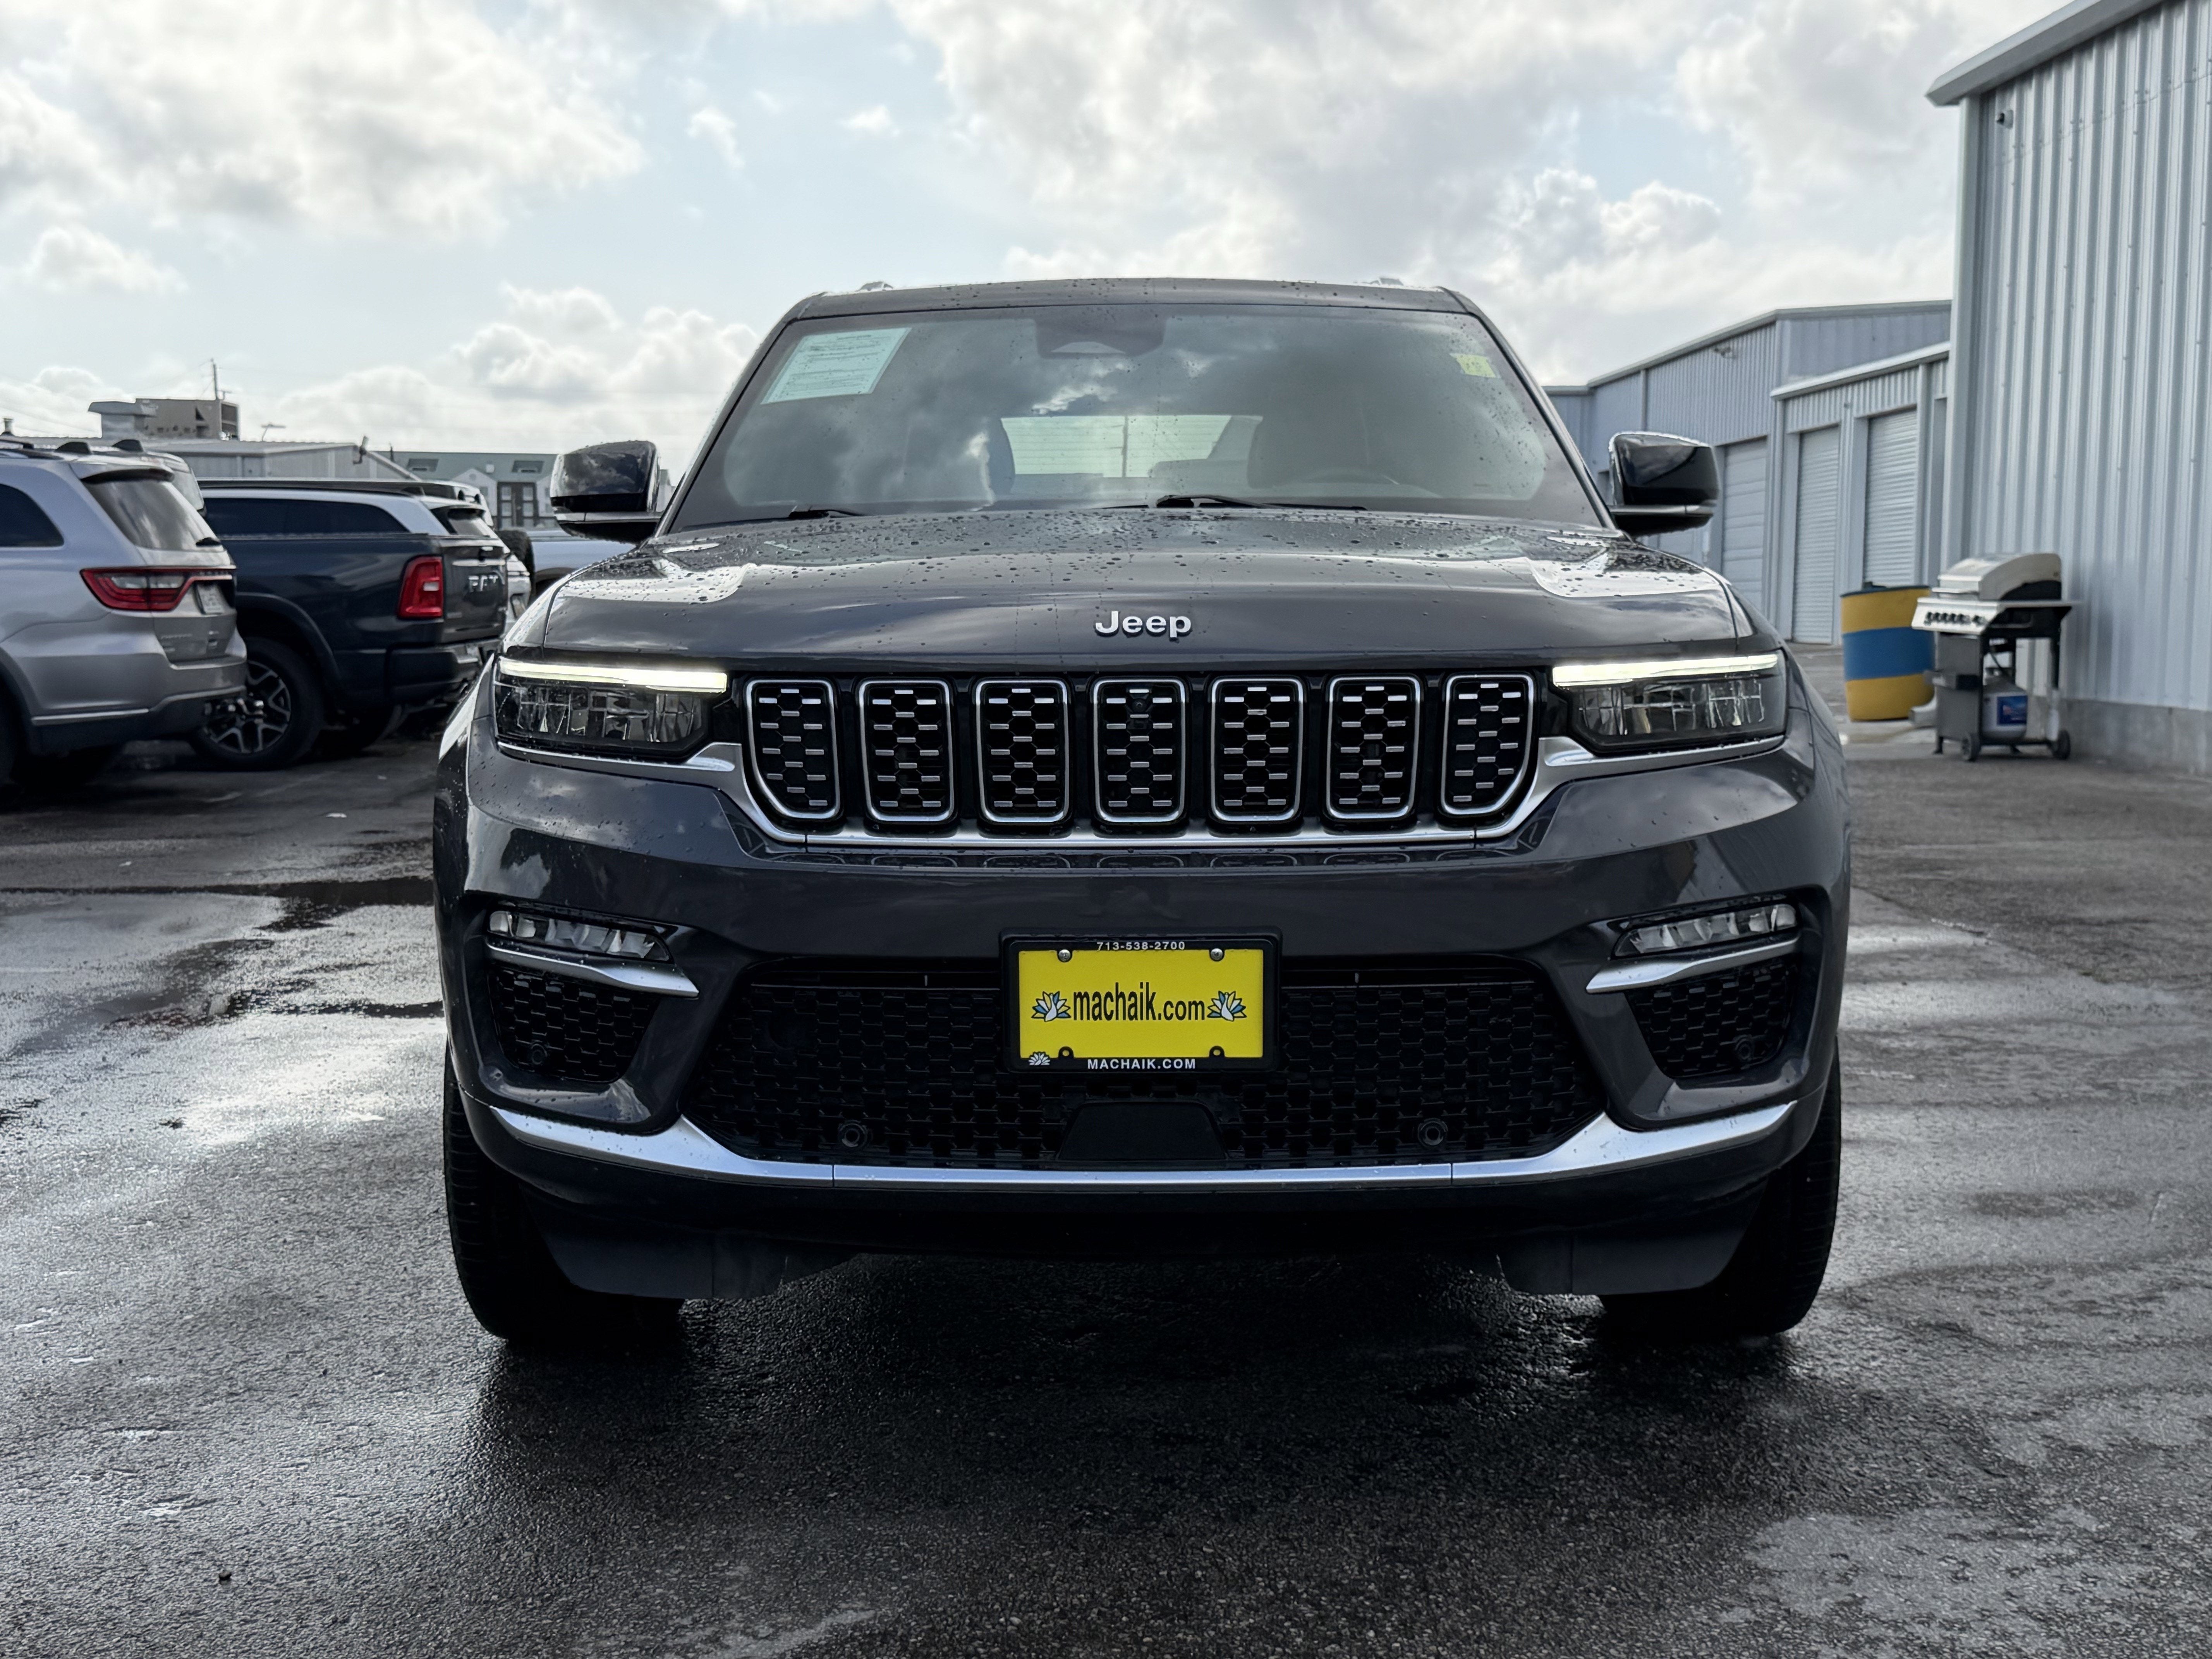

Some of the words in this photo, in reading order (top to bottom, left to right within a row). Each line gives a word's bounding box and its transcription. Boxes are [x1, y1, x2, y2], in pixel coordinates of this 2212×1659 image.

[1095, 611, 1191, 638] Jeep
[1097, 941, 1185, 951] 713-538-2700
[1073, 982, 1205, 1021] machaik.com
[1087, 1059, 1196, 1070] MACHAIK.COM
